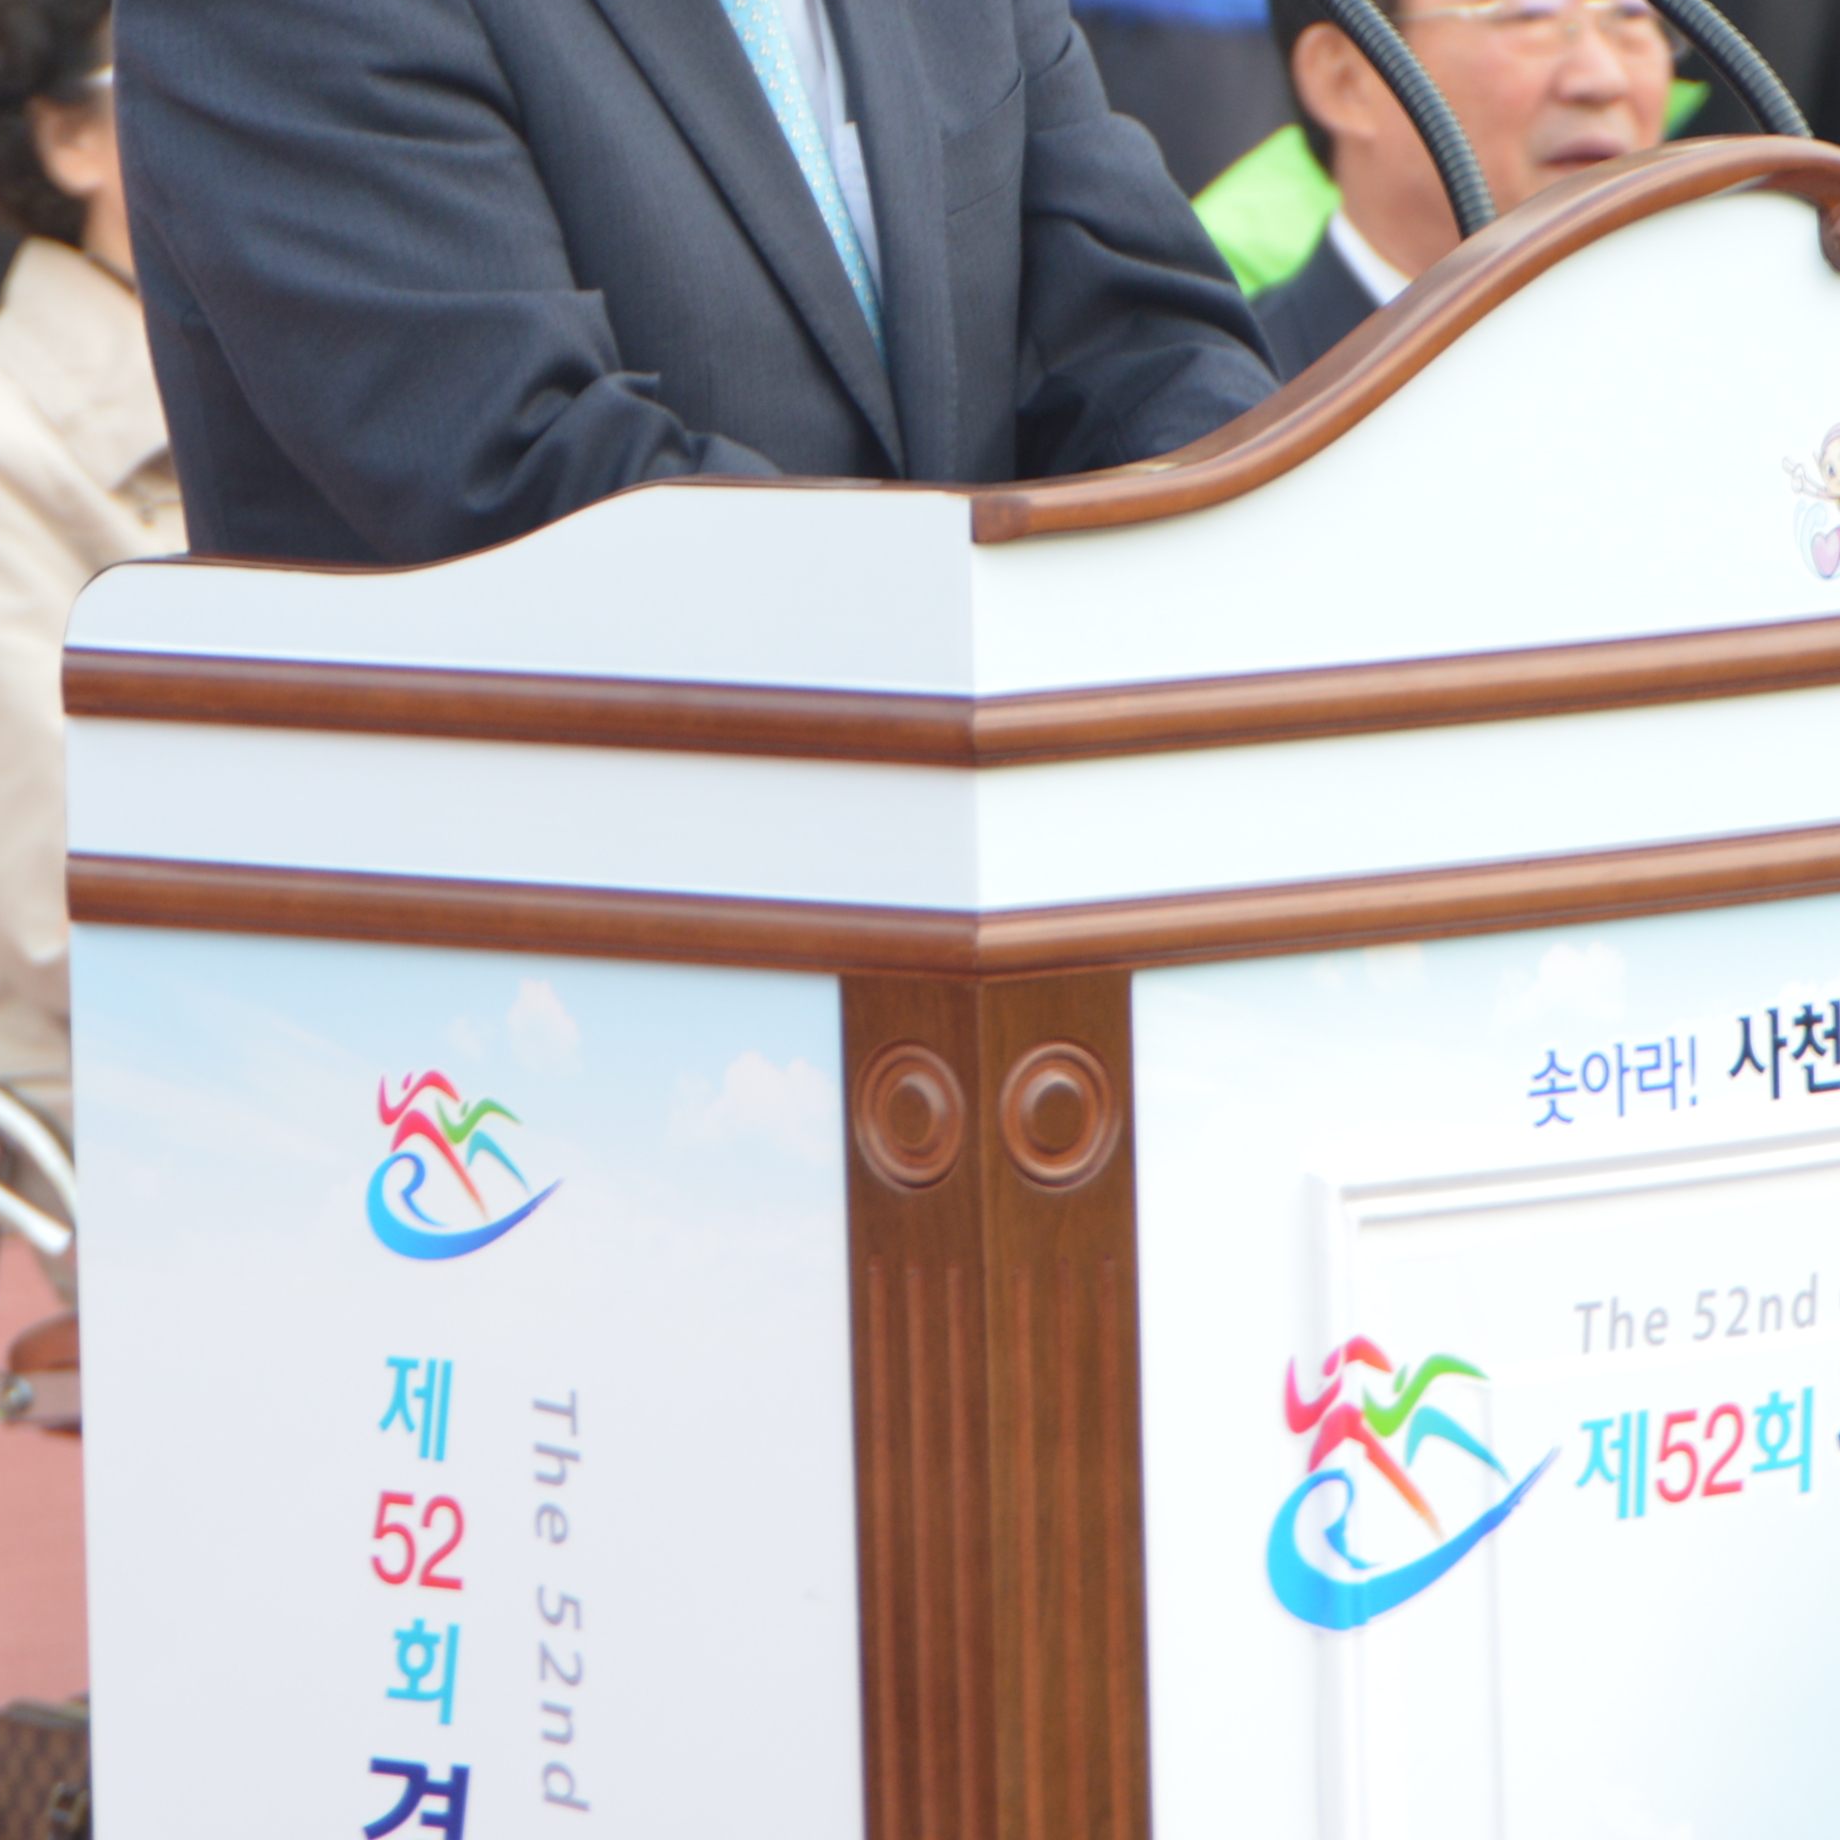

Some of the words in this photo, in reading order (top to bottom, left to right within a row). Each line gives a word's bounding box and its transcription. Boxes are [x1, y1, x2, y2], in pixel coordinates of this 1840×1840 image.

[1528, 1035, 1697, 1127] 솟아라!
[1574, 1296, 1669, 1354] The
[1692, 1272, 1818, 1341] 52nd
[532, 1389, 582, 1546] The
[1576, 1387, 1815, 1519] 제52회
[536, 1585, 591, 1813] 52nd
